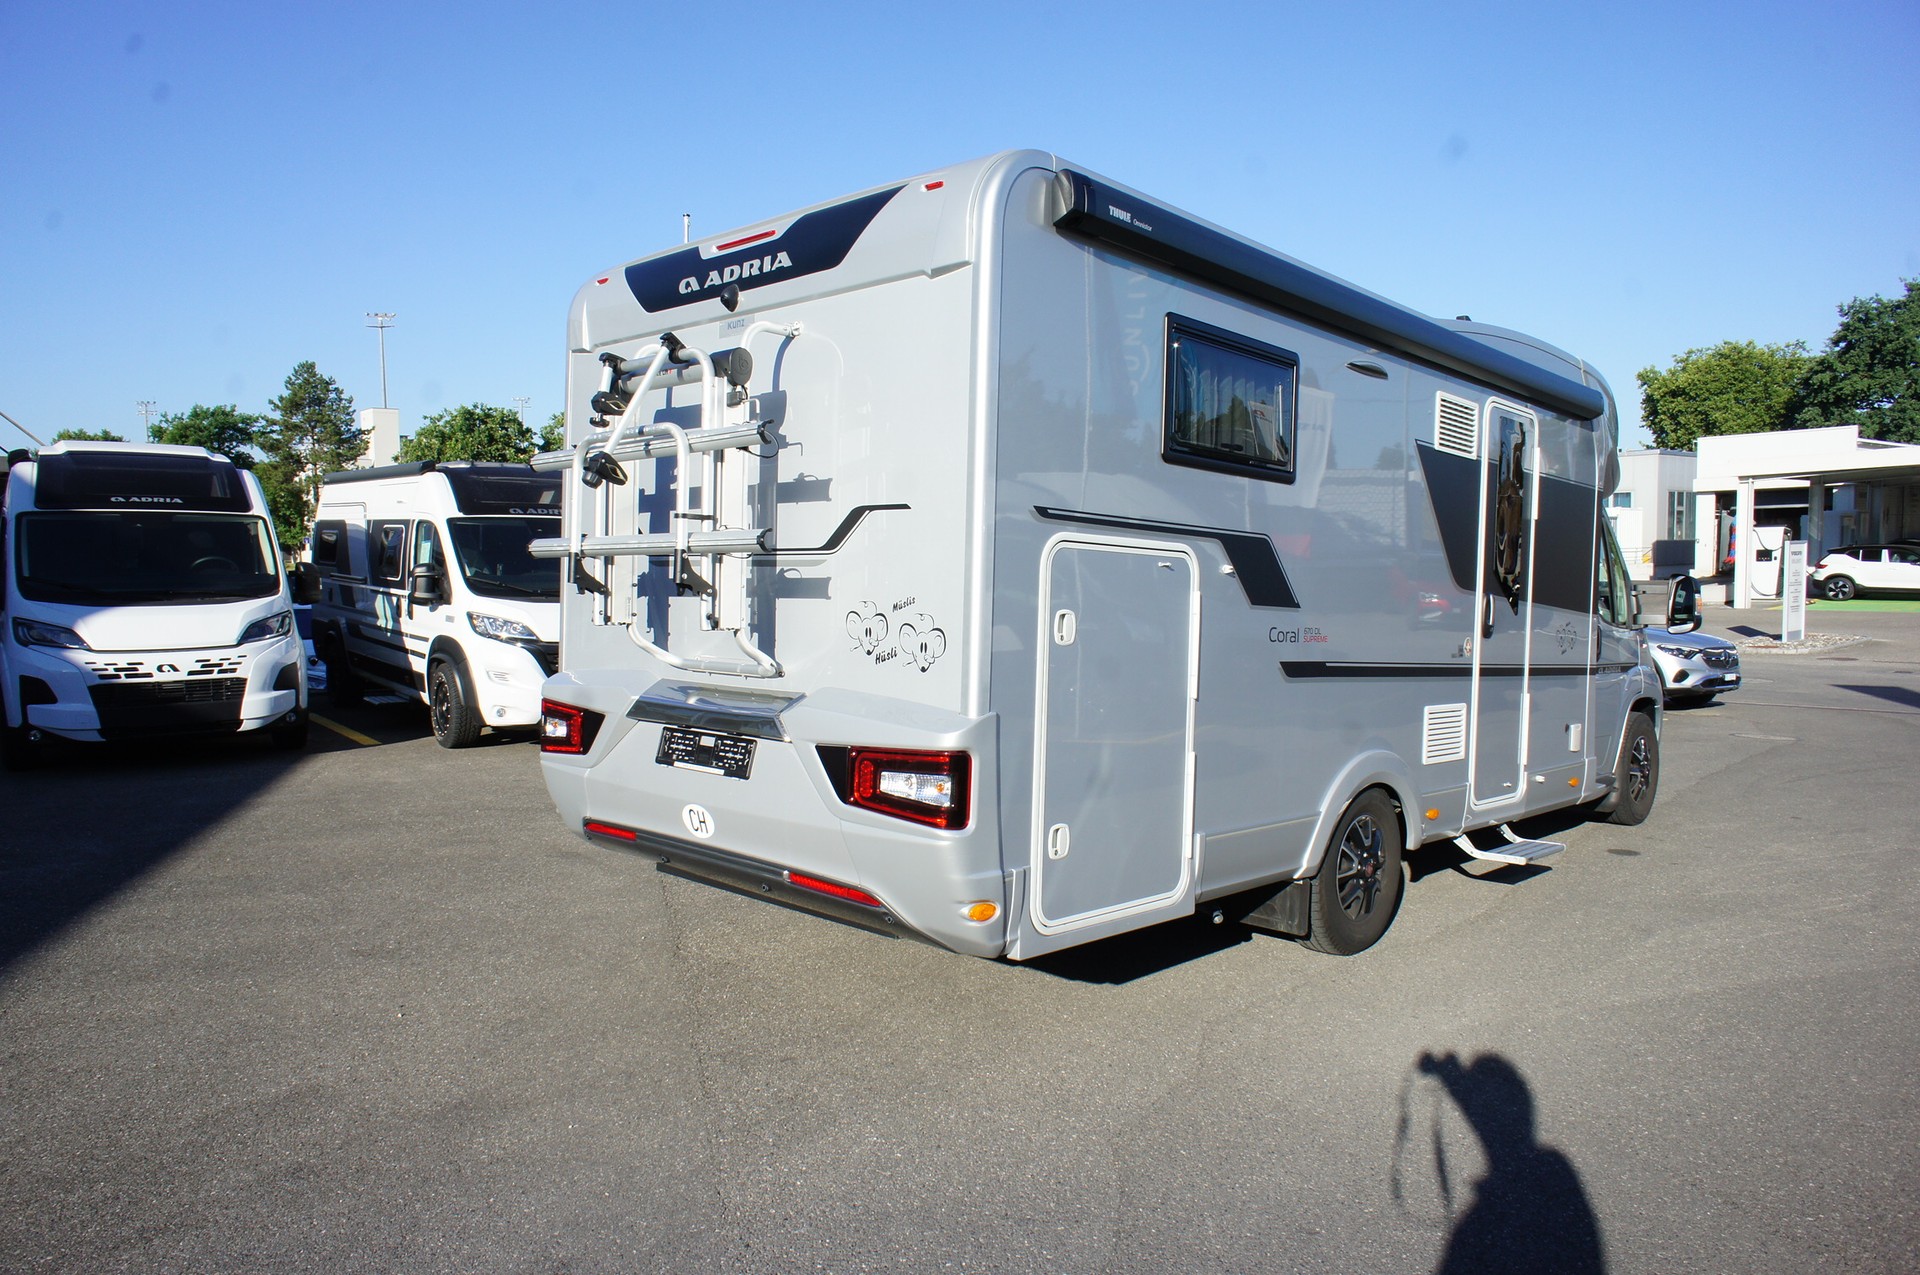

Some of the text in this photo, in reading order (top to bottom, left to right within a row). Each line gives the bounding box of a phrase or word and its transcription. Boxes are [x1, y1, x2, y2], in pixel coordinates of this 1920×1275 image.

[1109, 205, 1131, 223] THULE
[704, 251, 792, 288] ADRIA
[892, 596, 916, 612] Müslis
[1269, 626, 1300, 643] Coral
[875, 646, 898, 664] Hüsli
[688, 808, 709, 834] CH
